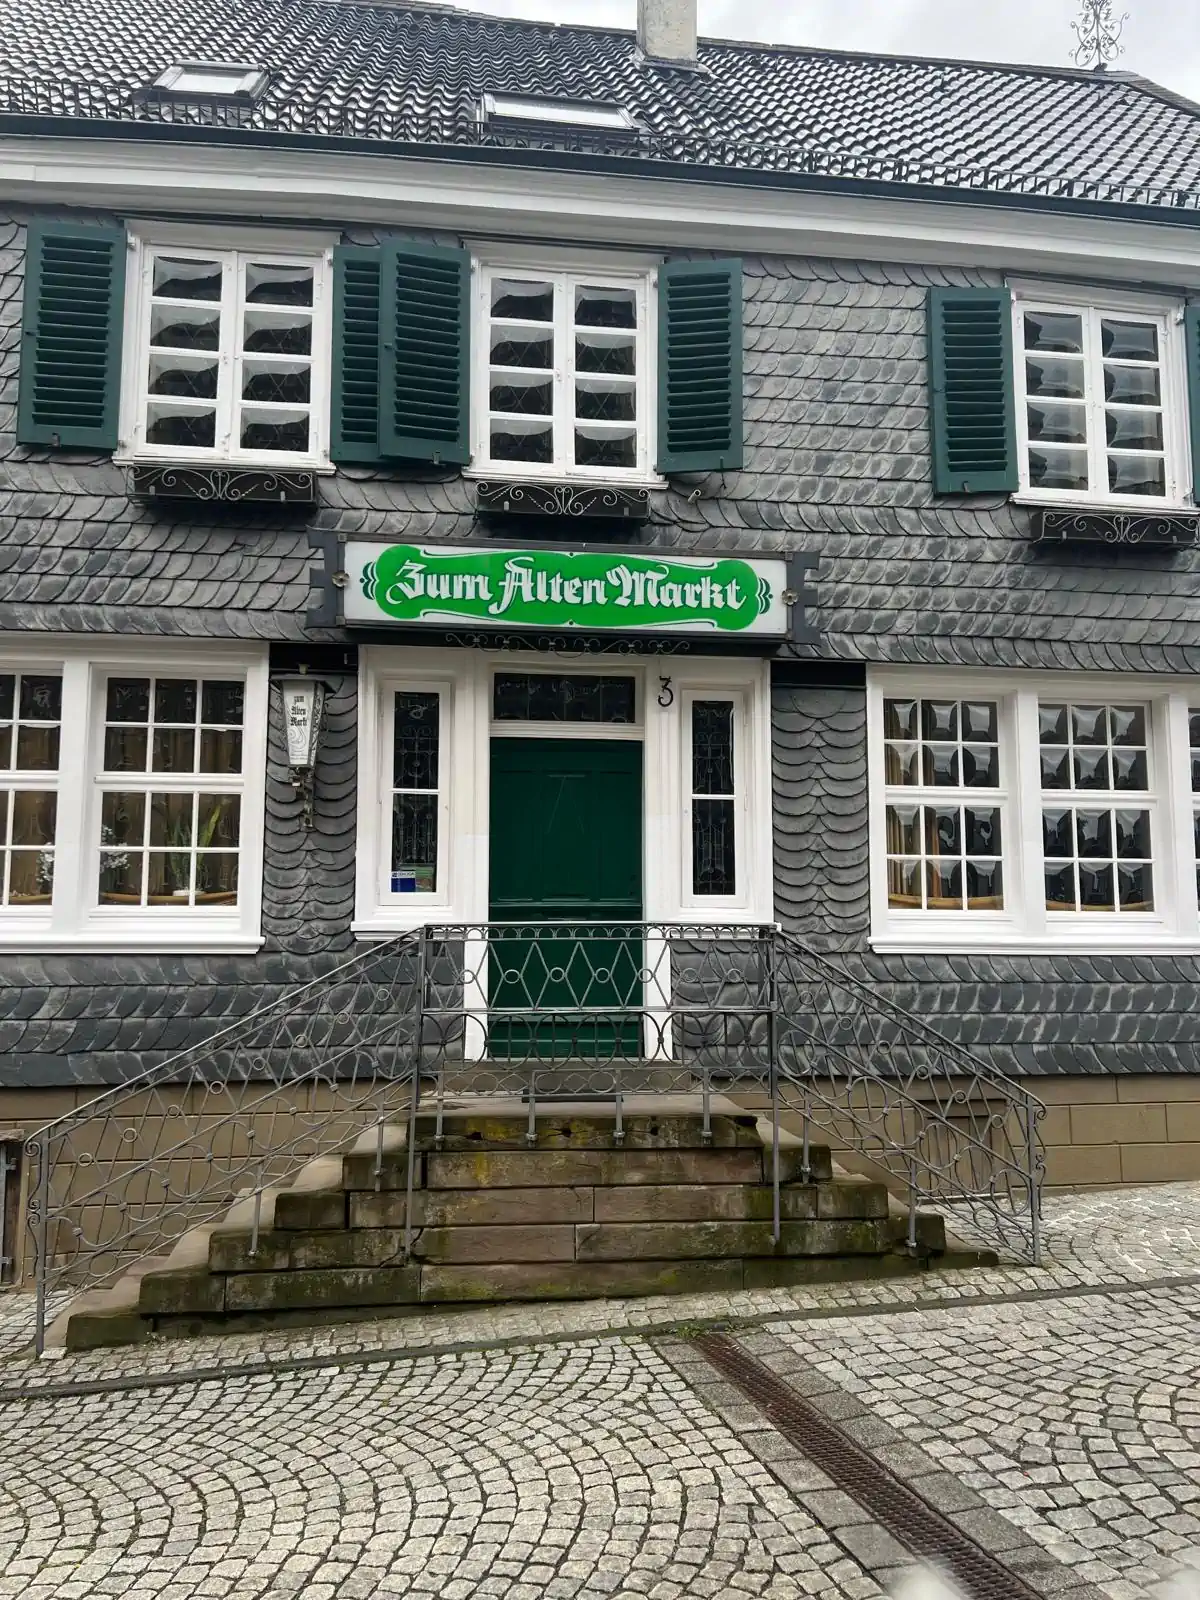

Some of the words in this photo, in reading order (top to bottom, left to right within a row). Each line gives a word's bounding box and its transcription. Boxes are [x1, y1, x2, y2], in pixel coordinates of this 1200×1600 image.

[385, 559, 493, 605] Zum
[488, 556, 609, 615] Alten
[605, 564, 747, 610] Markt
[657, 675, 674, 707] 3
